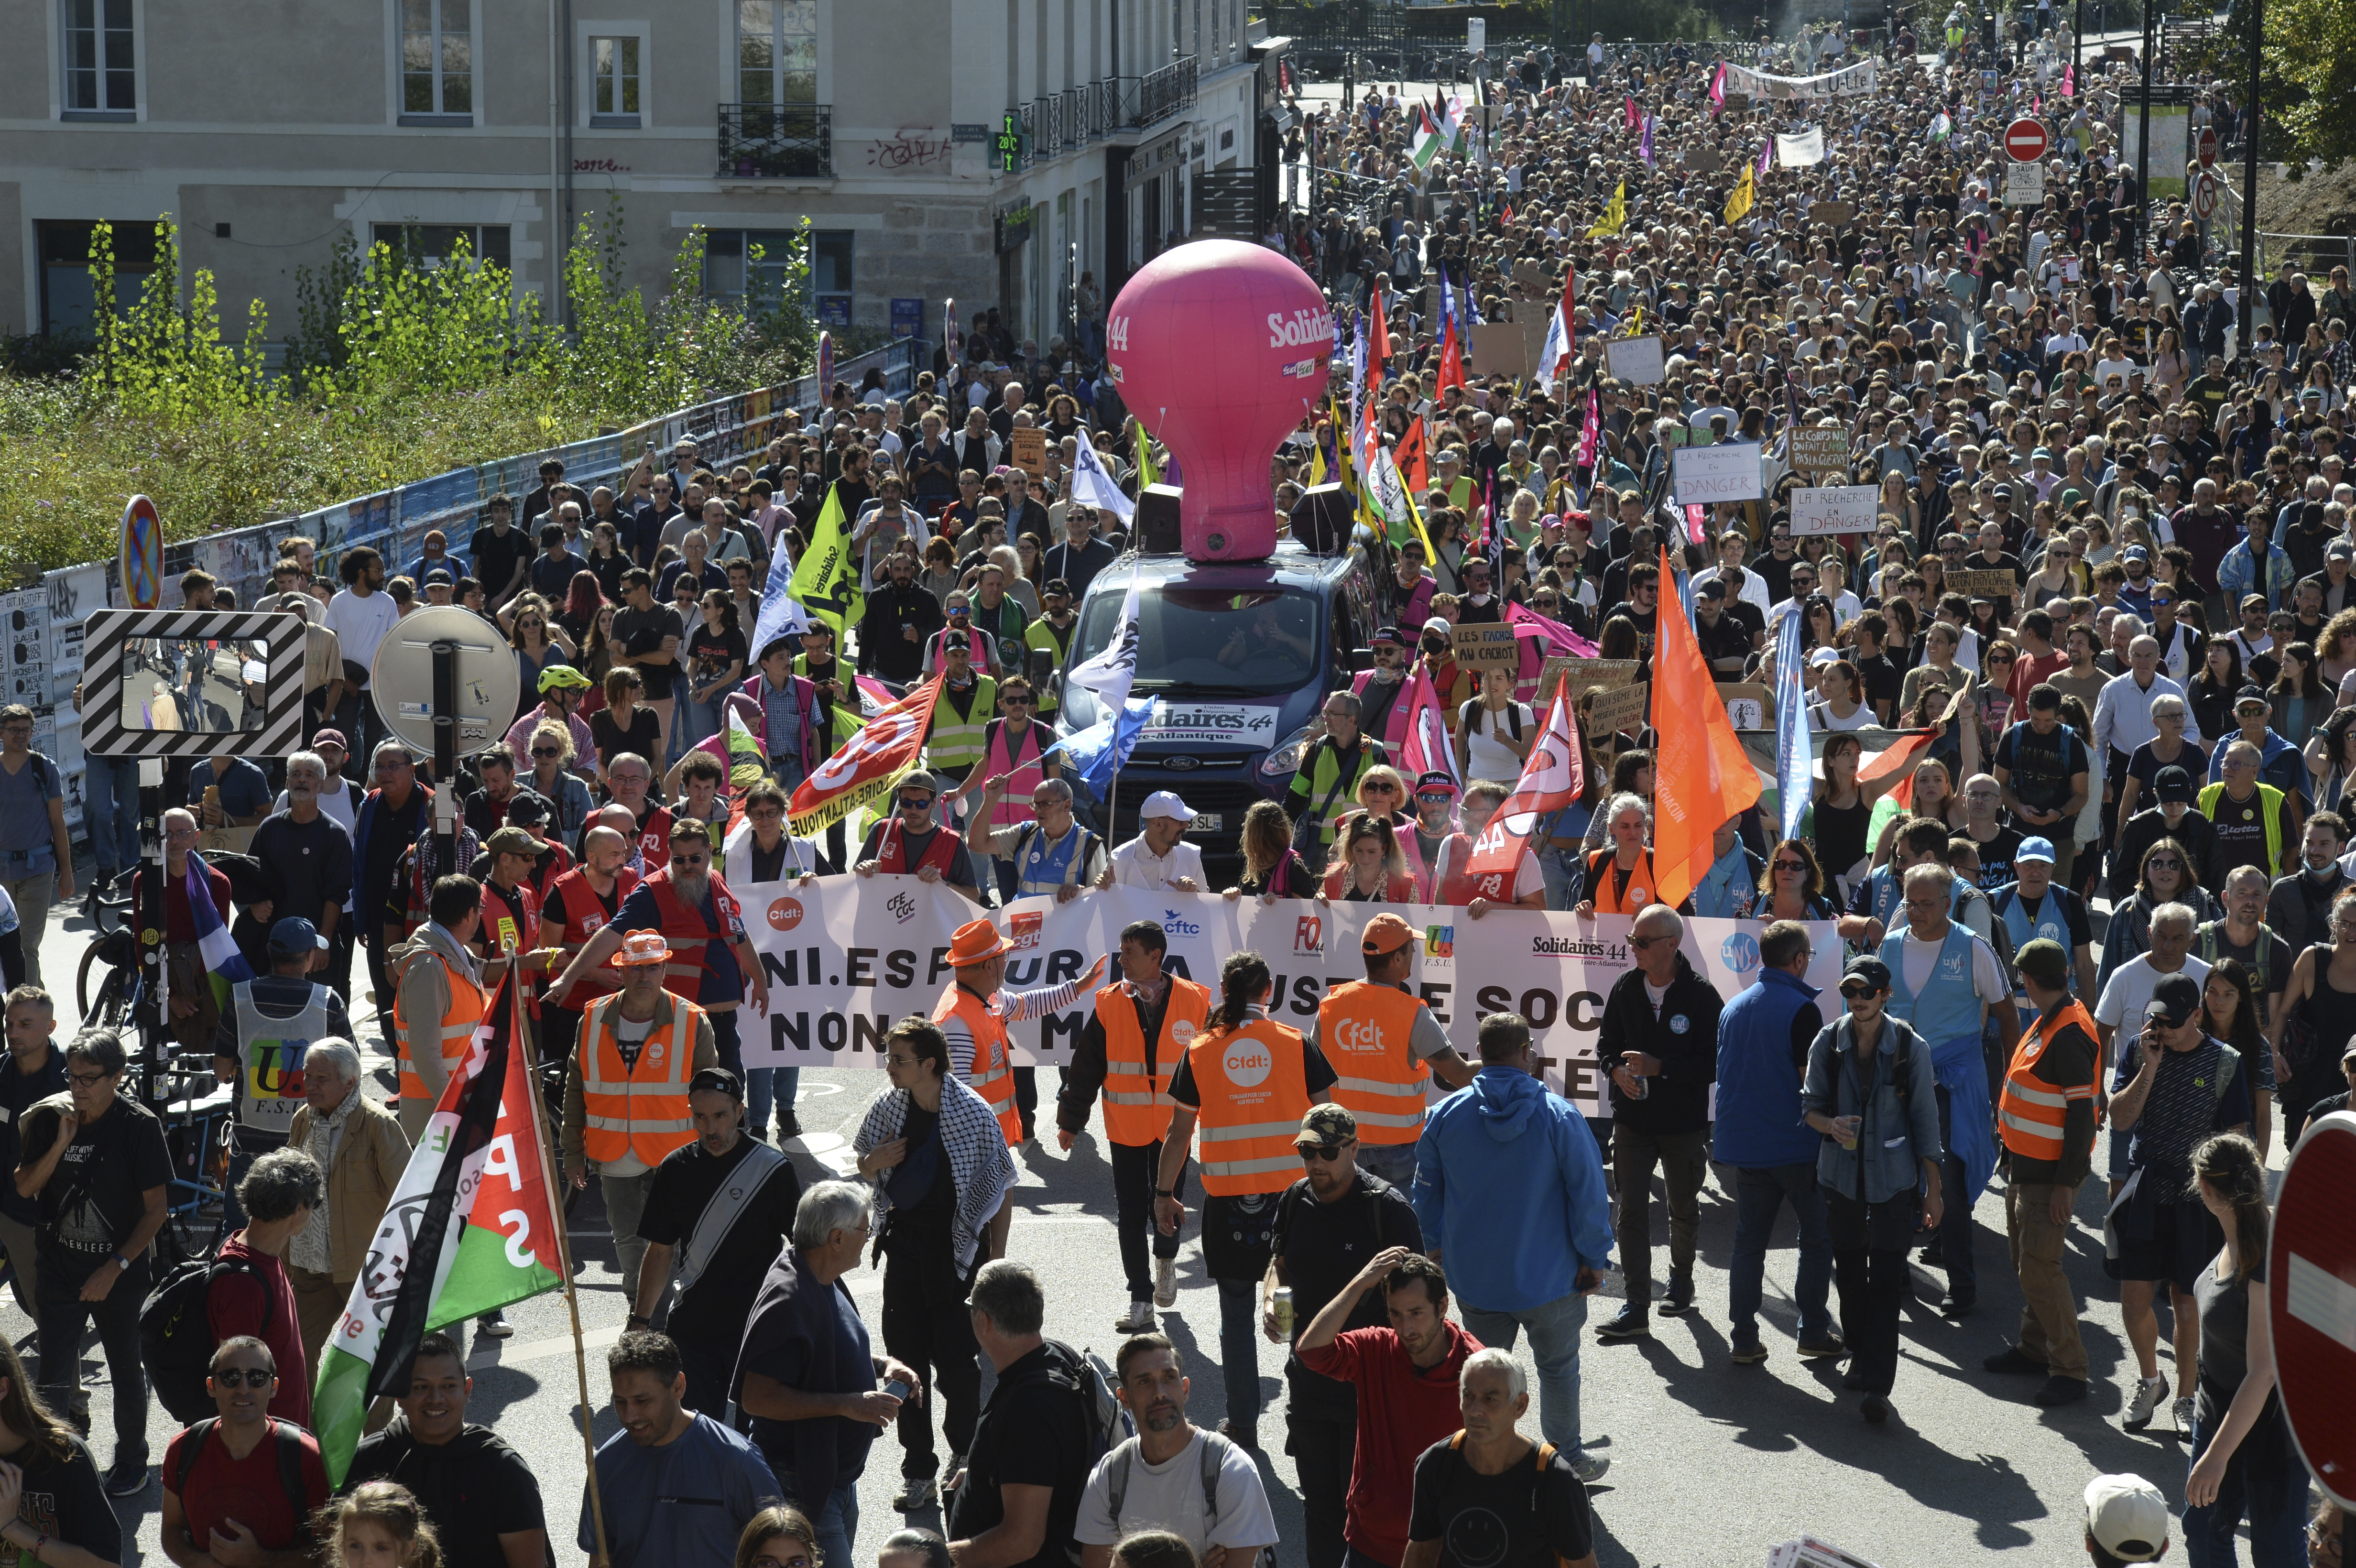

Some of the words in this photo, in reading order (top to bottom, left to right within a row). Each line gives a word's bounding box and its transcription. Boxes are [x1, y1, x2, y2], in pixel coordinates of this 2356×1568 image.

[1281, 62, 1289, 92] TABAC
[999, 134, 1017, 151] 20°C
[2200, 143, 2216, 156] STOP
[2016, 165, 2035, 174] SAUF
[1111, 316, 1129, 351] 44
[1613, 342, 1638, 353] MOINS
[1670, 427, 1714, 445] MARON
[1792, 429, 1804, 441] LE
[1805, 429, 1831, 441] CORPS
[1832, 430, 1846, 440] NU
[1681, 452, 1692, 461] LA
[1795, 453, 1809, 466] PAS
[1809, 454, 1818, 466] LA
[1818, 453, 1848, 467] GUERRE
[1681, 477, 1752, 497] DANGER
[1799, 493, 1811, 505] LA
[1820, 492, 1874, 505] RECHERCHE
[1828, 509, 1839, 517] EN
[1809, 514, 1871, 531] DANGER
[1947, 571, 1971, 579] QUAND
[1974, 570, 2004, 579] EST-CE
[1948, 579, 1970, 588] QU'ON
[1973, 579, 1987, 587] FAIT
[1986, 578, 2012, 587] COMME
[1458, 632, 1479, 643] LES
[1483, 630, 1515, 642] FACHOS
[698, 645, 728, 656] GREMLINS
[1459, 648, 1475, 661] AU
[1479, 645, 1515, 660] CACHOT
[466, 679, 482, 687] NANTES
[1595, 697, 1611, 709] QUI
[1612, 692, 1631, 705] SÈME
[1635, 687, 1644, 698] LA
[1593, 708, 1615, 722] MISÈRE
[1617, 700, 1644, 716] RÉCOLTE
[1247, 714, 1273, 732] 44
[1593, 723, 1604, 733] LA
[1615, 712, 1641, 728] COLÈRE
[1136, 732, 1233, 741] re-Atlantique
[1171, 758, 1191, 767] Ford
[2228, 825, 2260, 833] lotto
[641, 834, 659, 850] FO
[1472, 821, 1505, 858] 44
[1478, 876, 1500, 895] FO
[887, 891, 905, 911] CFE
[769, 908, 801, 920] Cfdt:
[896, 898, 915, 919] CGC
[1164, 920, 1200, 935] cftc
[1294, 915, 1321, 951] FO
[1009, 929, 1041, 948] cgt
[1315, 942, 1324, 953] 44
[1533, 936, 1604, 955] Solidaires
[1606, 943, 1627, 960] 44
[1425, 958, 1451, 967] F.S.U.
[1581, 958, 1629, 969] Loire-Atlantique
[1173, 1028, 1194, 1037] Cfdt:
[1334, 1018, 1385, 1051] Cfdt
[1226, 1055, 1270, 1071] Cfdt:
[66, 1145, 79, 1154] LIFE
[63, 1153, 84, 1163] MUSIC,
